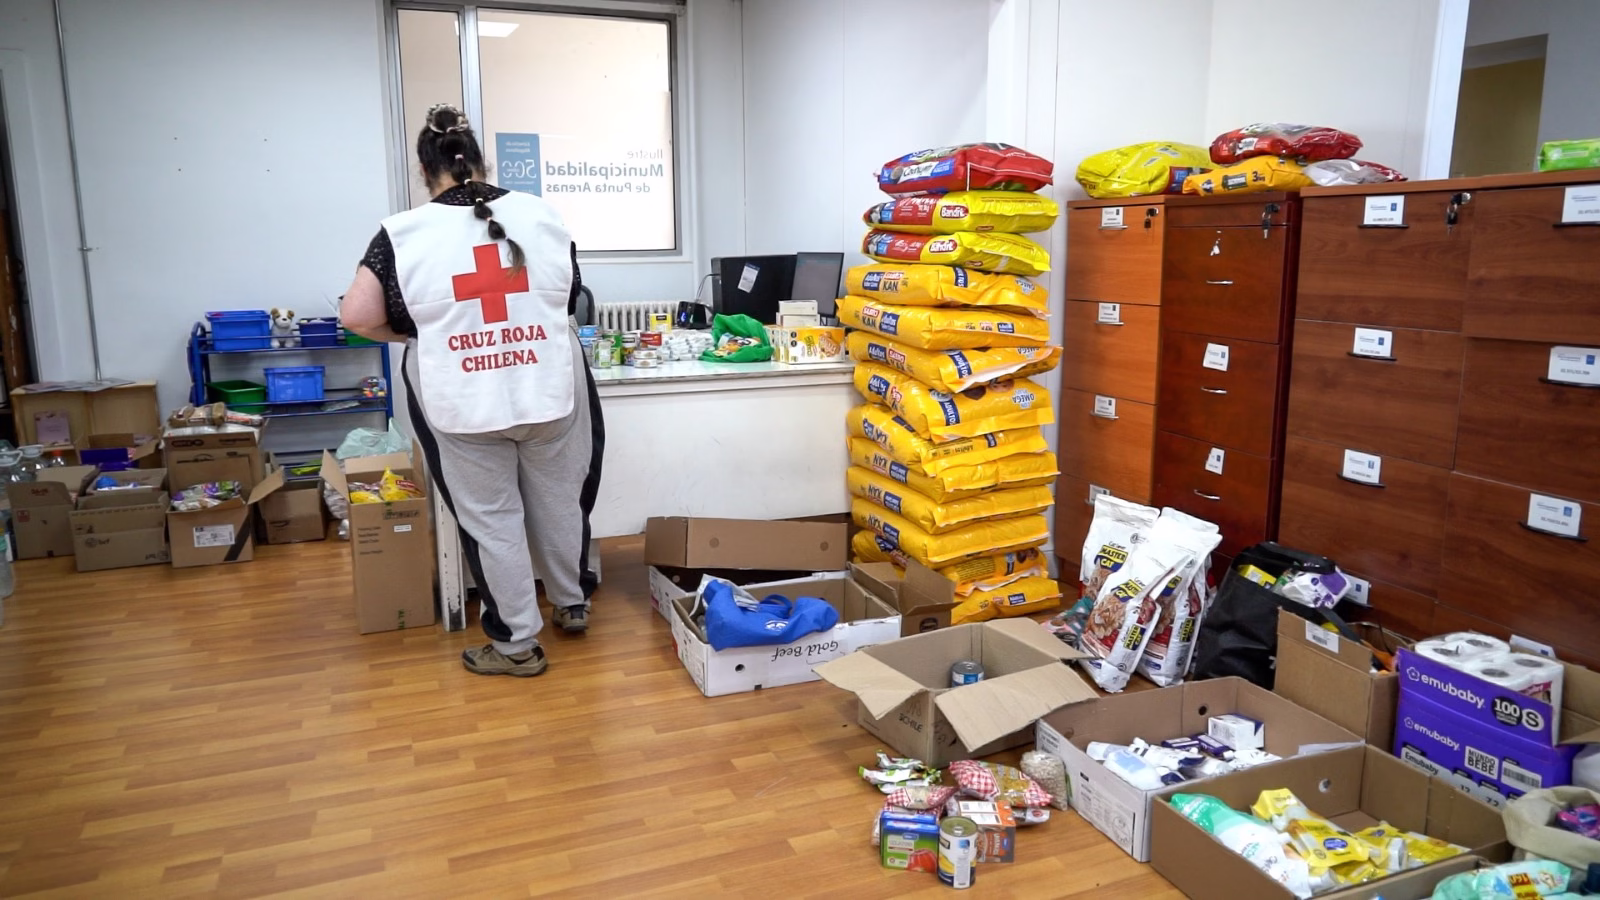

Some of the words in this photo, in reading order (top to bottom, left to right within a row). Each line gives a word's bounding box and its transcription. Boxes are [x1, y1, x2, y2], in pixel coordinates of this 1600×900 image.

[883, 280, 899, 292] KAN
[448, 331, 496, 351] CRUZ
[501, 325, 547, 344] ROJA
[462, 349, 538, 373] CHILENA
[1012, 393, 1035, 404] OMEGA
[1101, 547, 1126, 560] MASTER
[1100, 558, 1115, 568] CAT
[771, 646, 802, 662] Beef
[805, 640, 839, 656] Gold
[1421, 674, 1485, 709] emubaby
[1494, 698, 1520, 717] 100
[1525, 710, 1540, 729] S
[1414, 722, 1460, 751] emubaby
[1404, 752, 1439, 775] Emubaby
[1468, 748, 1496, 766] MUNDO
